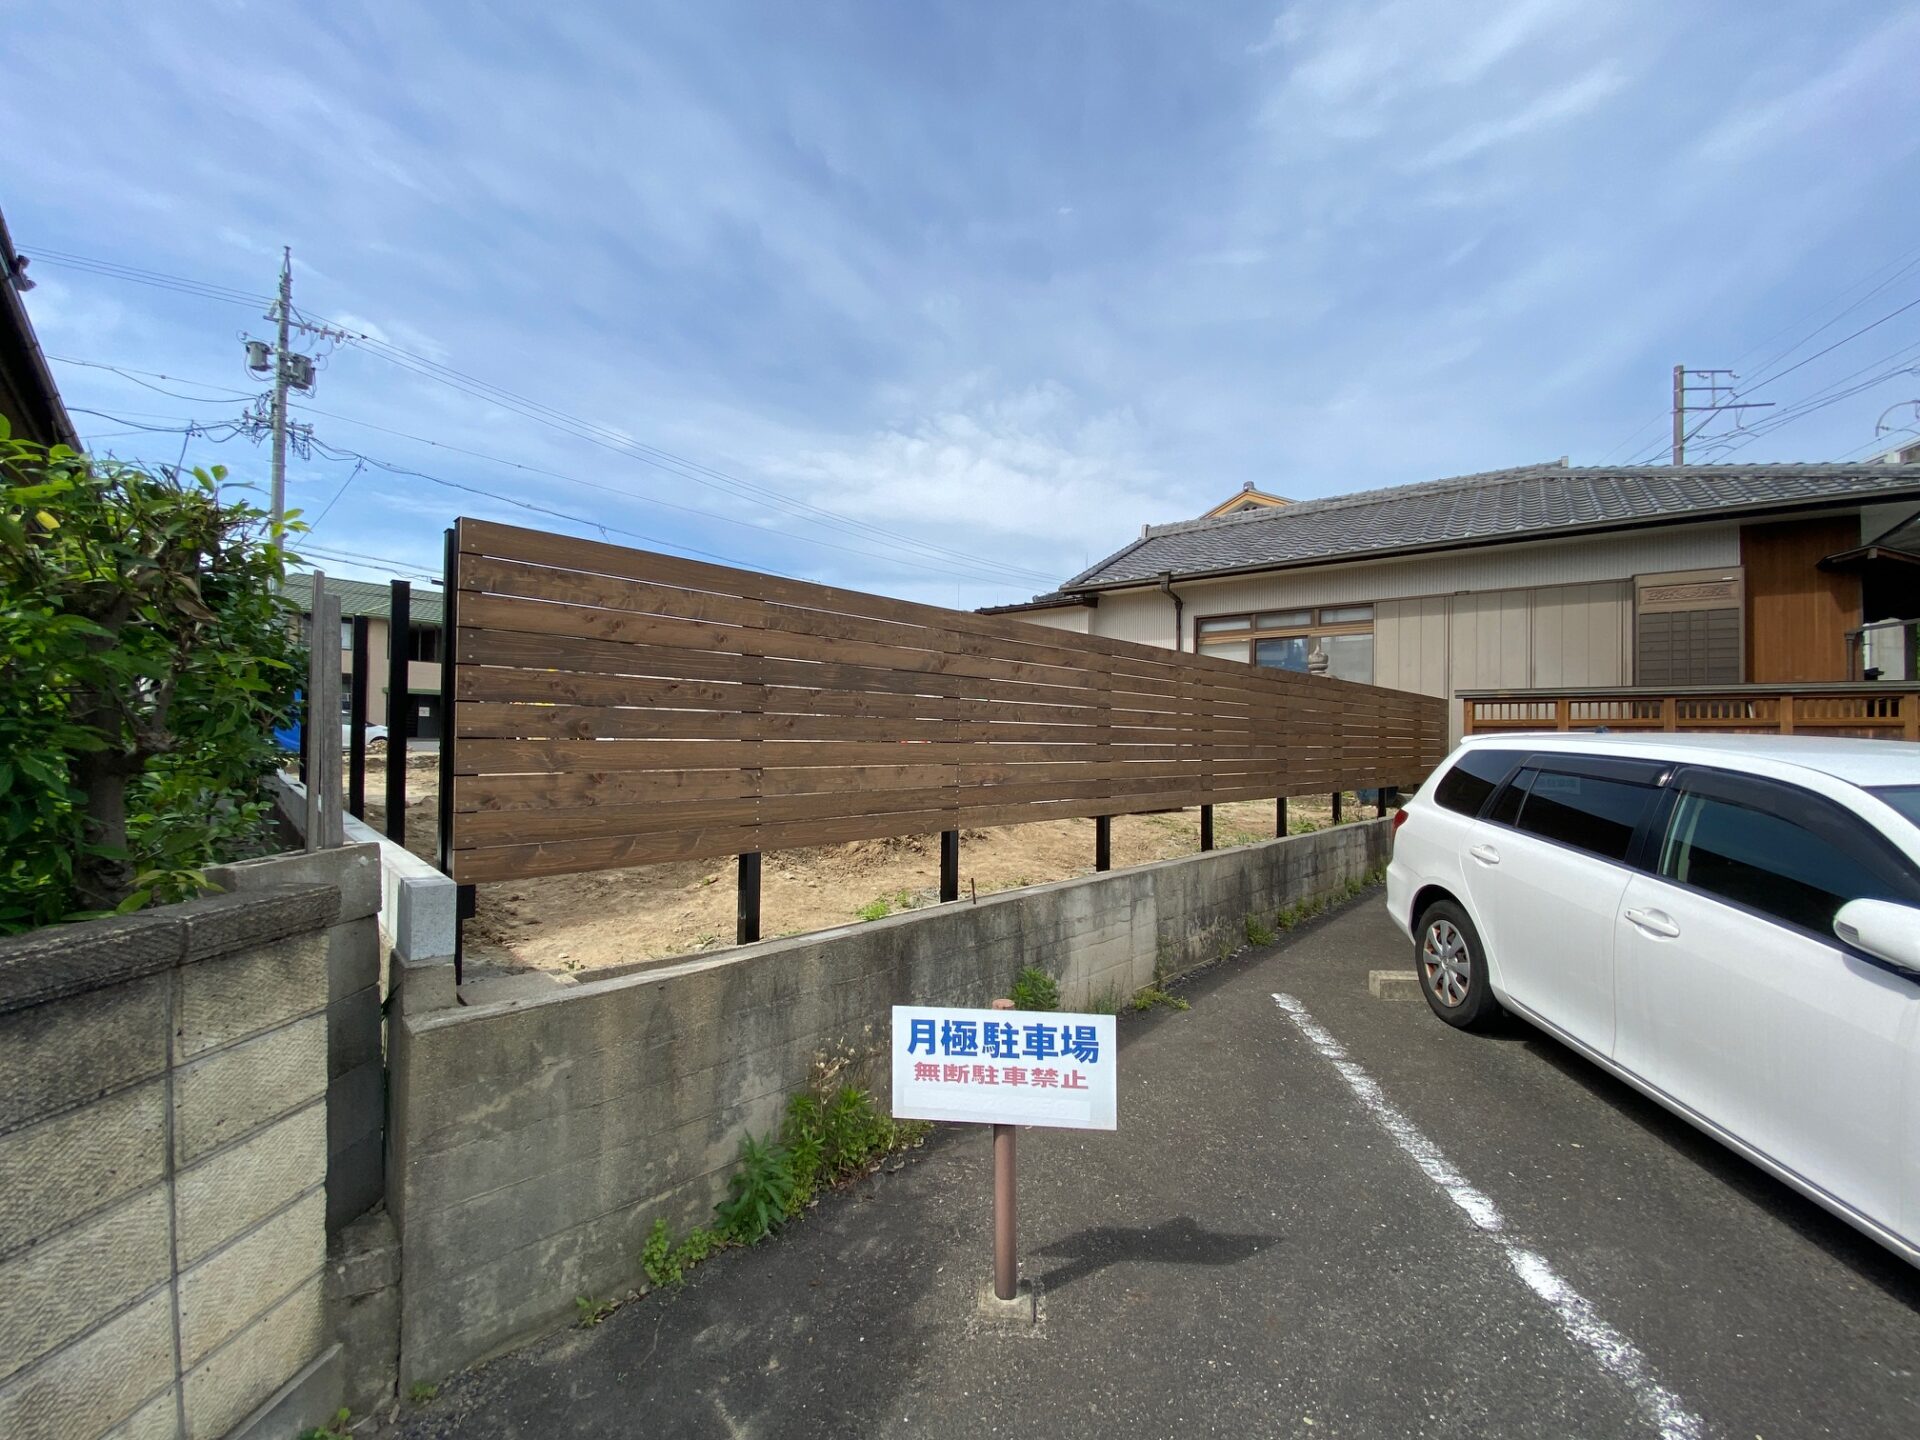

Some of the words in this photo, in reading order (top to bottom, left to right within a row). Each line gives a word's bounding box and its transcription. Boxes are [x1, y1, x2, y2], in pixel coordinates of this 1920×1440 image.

[907, 1019, 1099, 1063] 月極駐車場
[914, 1061, 1088, 1090] 無断駐車禁止
